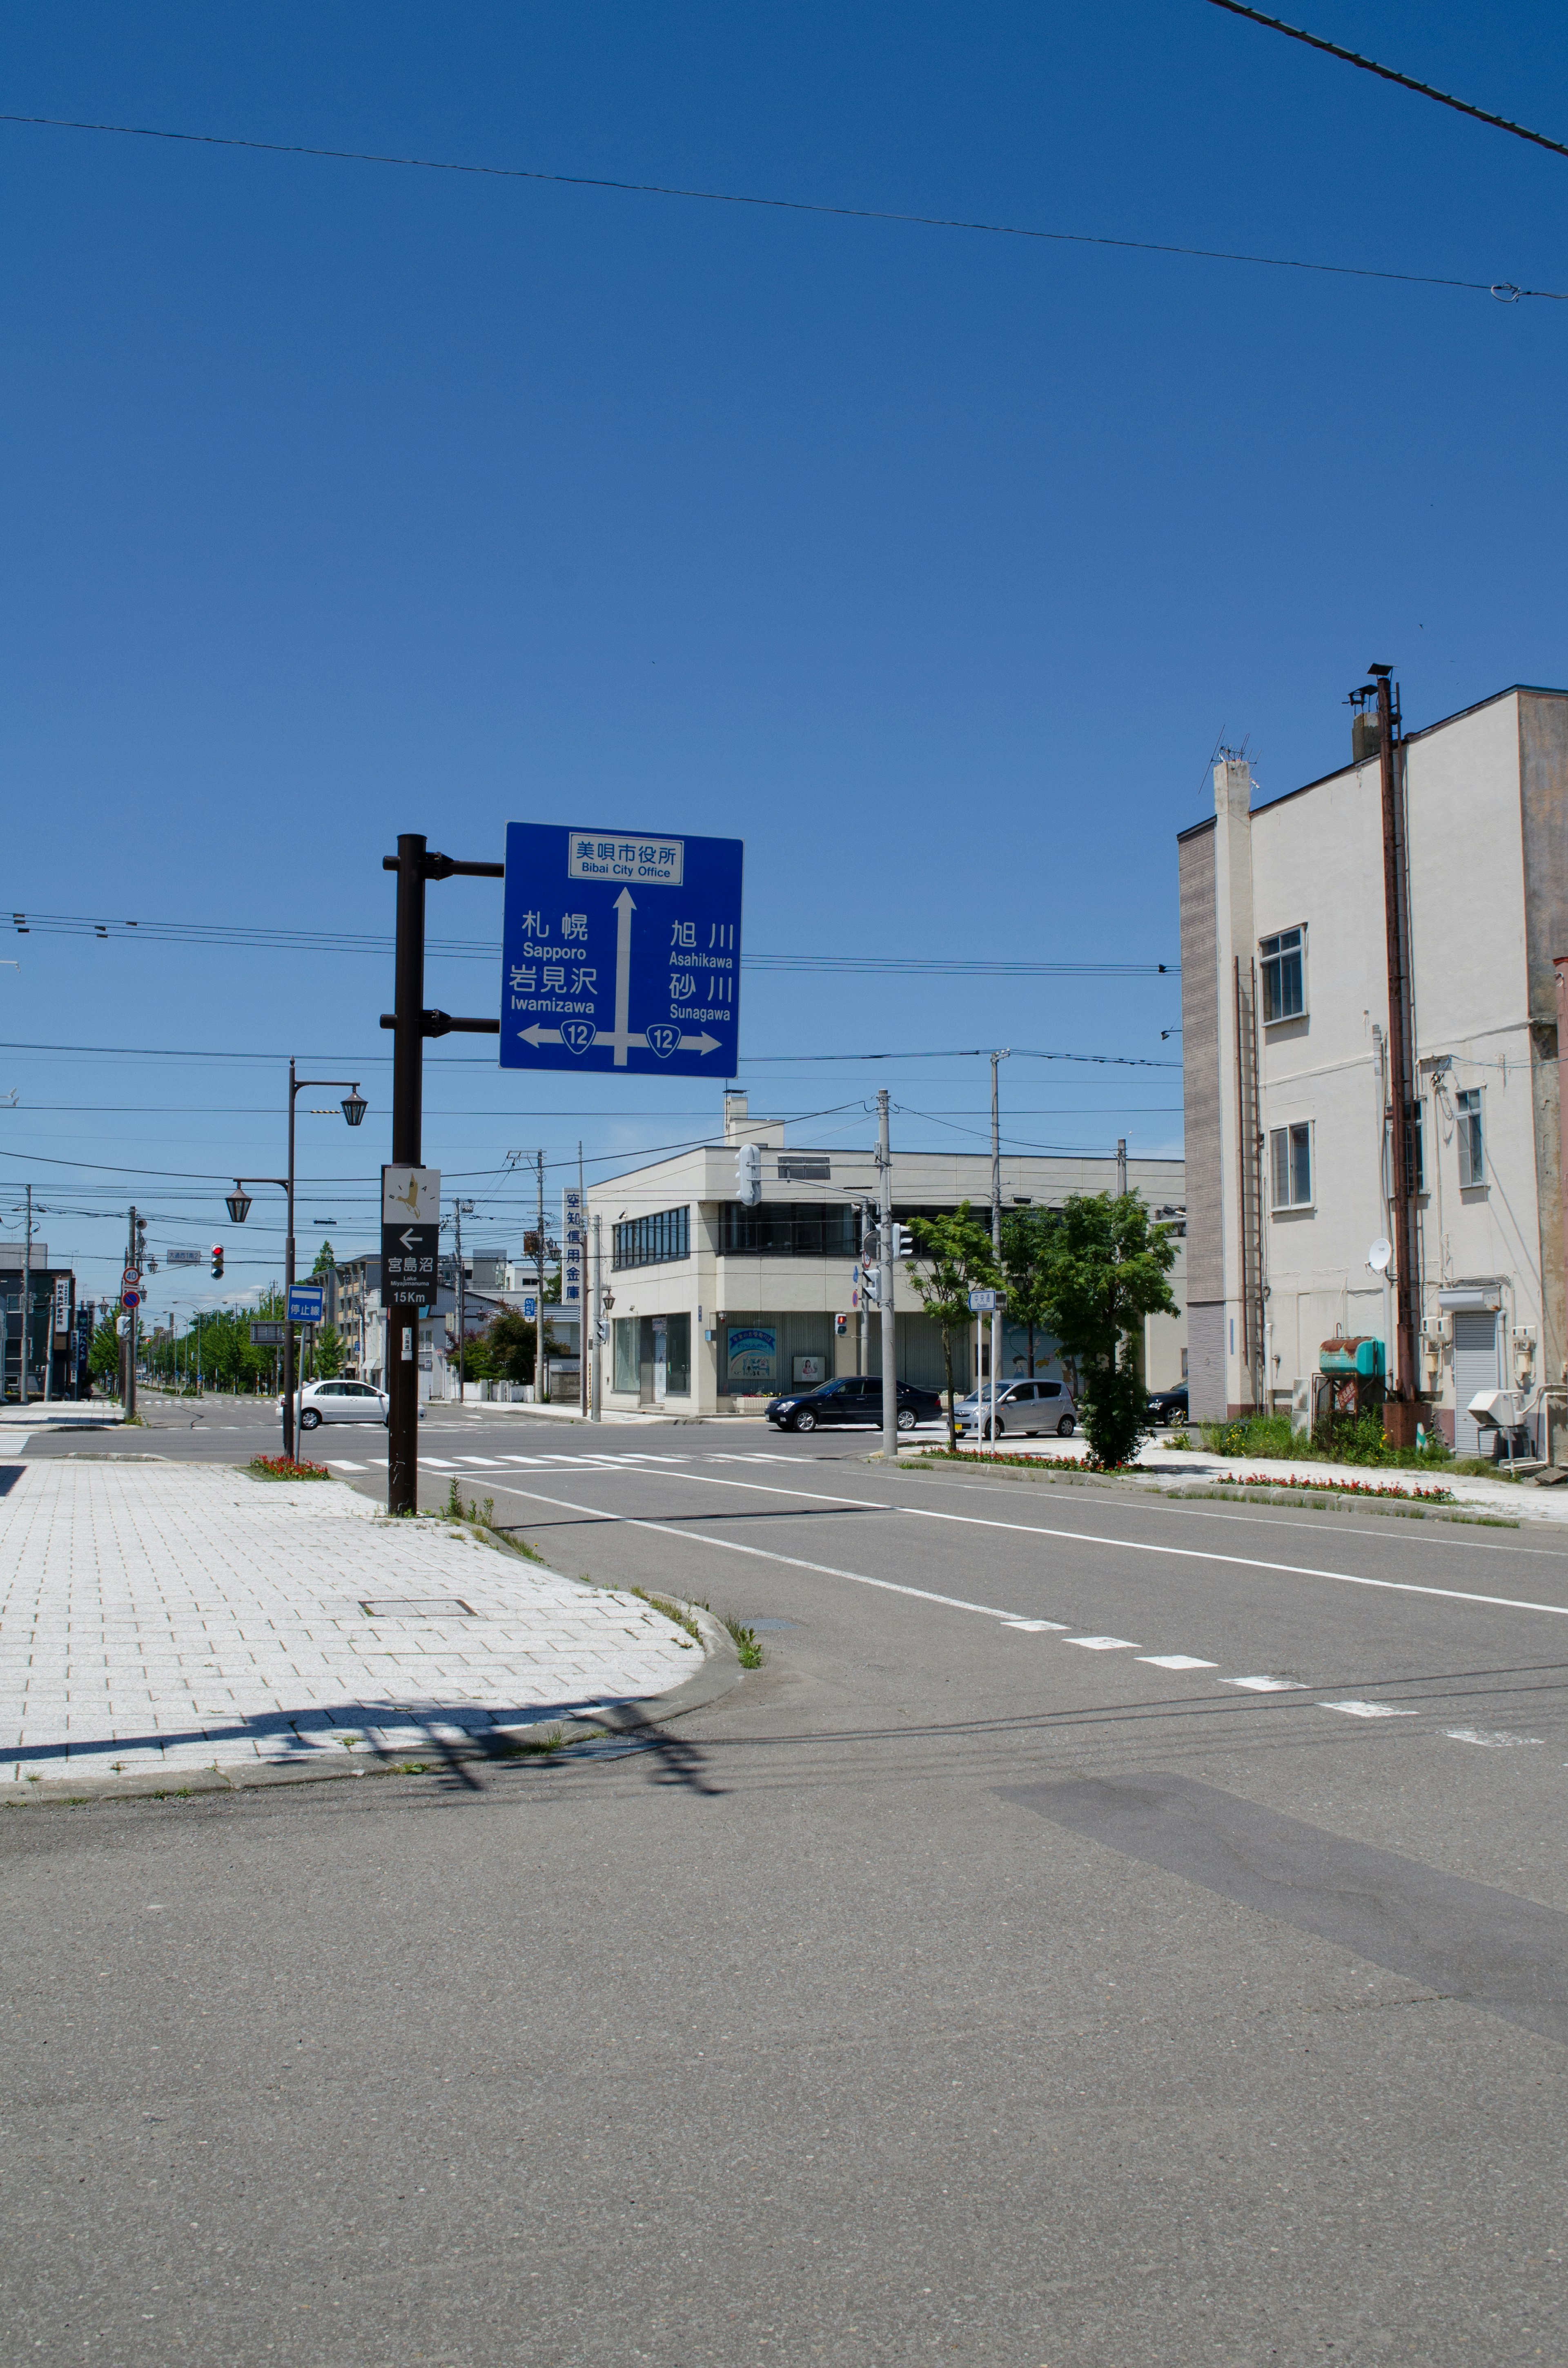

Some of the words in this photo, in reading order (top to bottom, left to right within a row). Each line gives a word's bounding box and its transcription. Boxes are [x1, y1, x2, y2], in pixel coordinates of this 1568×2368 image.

[576, 841, 676, 865] 美唄市役所
[582, 862, 608, 873] Bibai
[613, 864, 633, 876] City
[638, 866, 670, 878] Office
[522, 910, 588, 941] 札幌
[670, 920, 733, 950] 旭川
[523, 942, 586, 961] Sapporo
[669, 951, 732, 968] Asahikawa
[509, 964, 598, 994] 岩見沢
[669, 973, 732, 1003] 砂川
[511, 995, 595, 1014] Iwamizawa
[670, 1003, 730, 1022] Sunagawa
[568, 1025, 588, 1044] 12
[654, 1029, 673, 1048] 12
[566, 1193, 580, 1300] 空知信用金庫
[388, 1257, 433, 1272] 宮島沼
[974, 1294, 990, 1303] 中央通
[291, 1304, 320, 1316] 停止線
